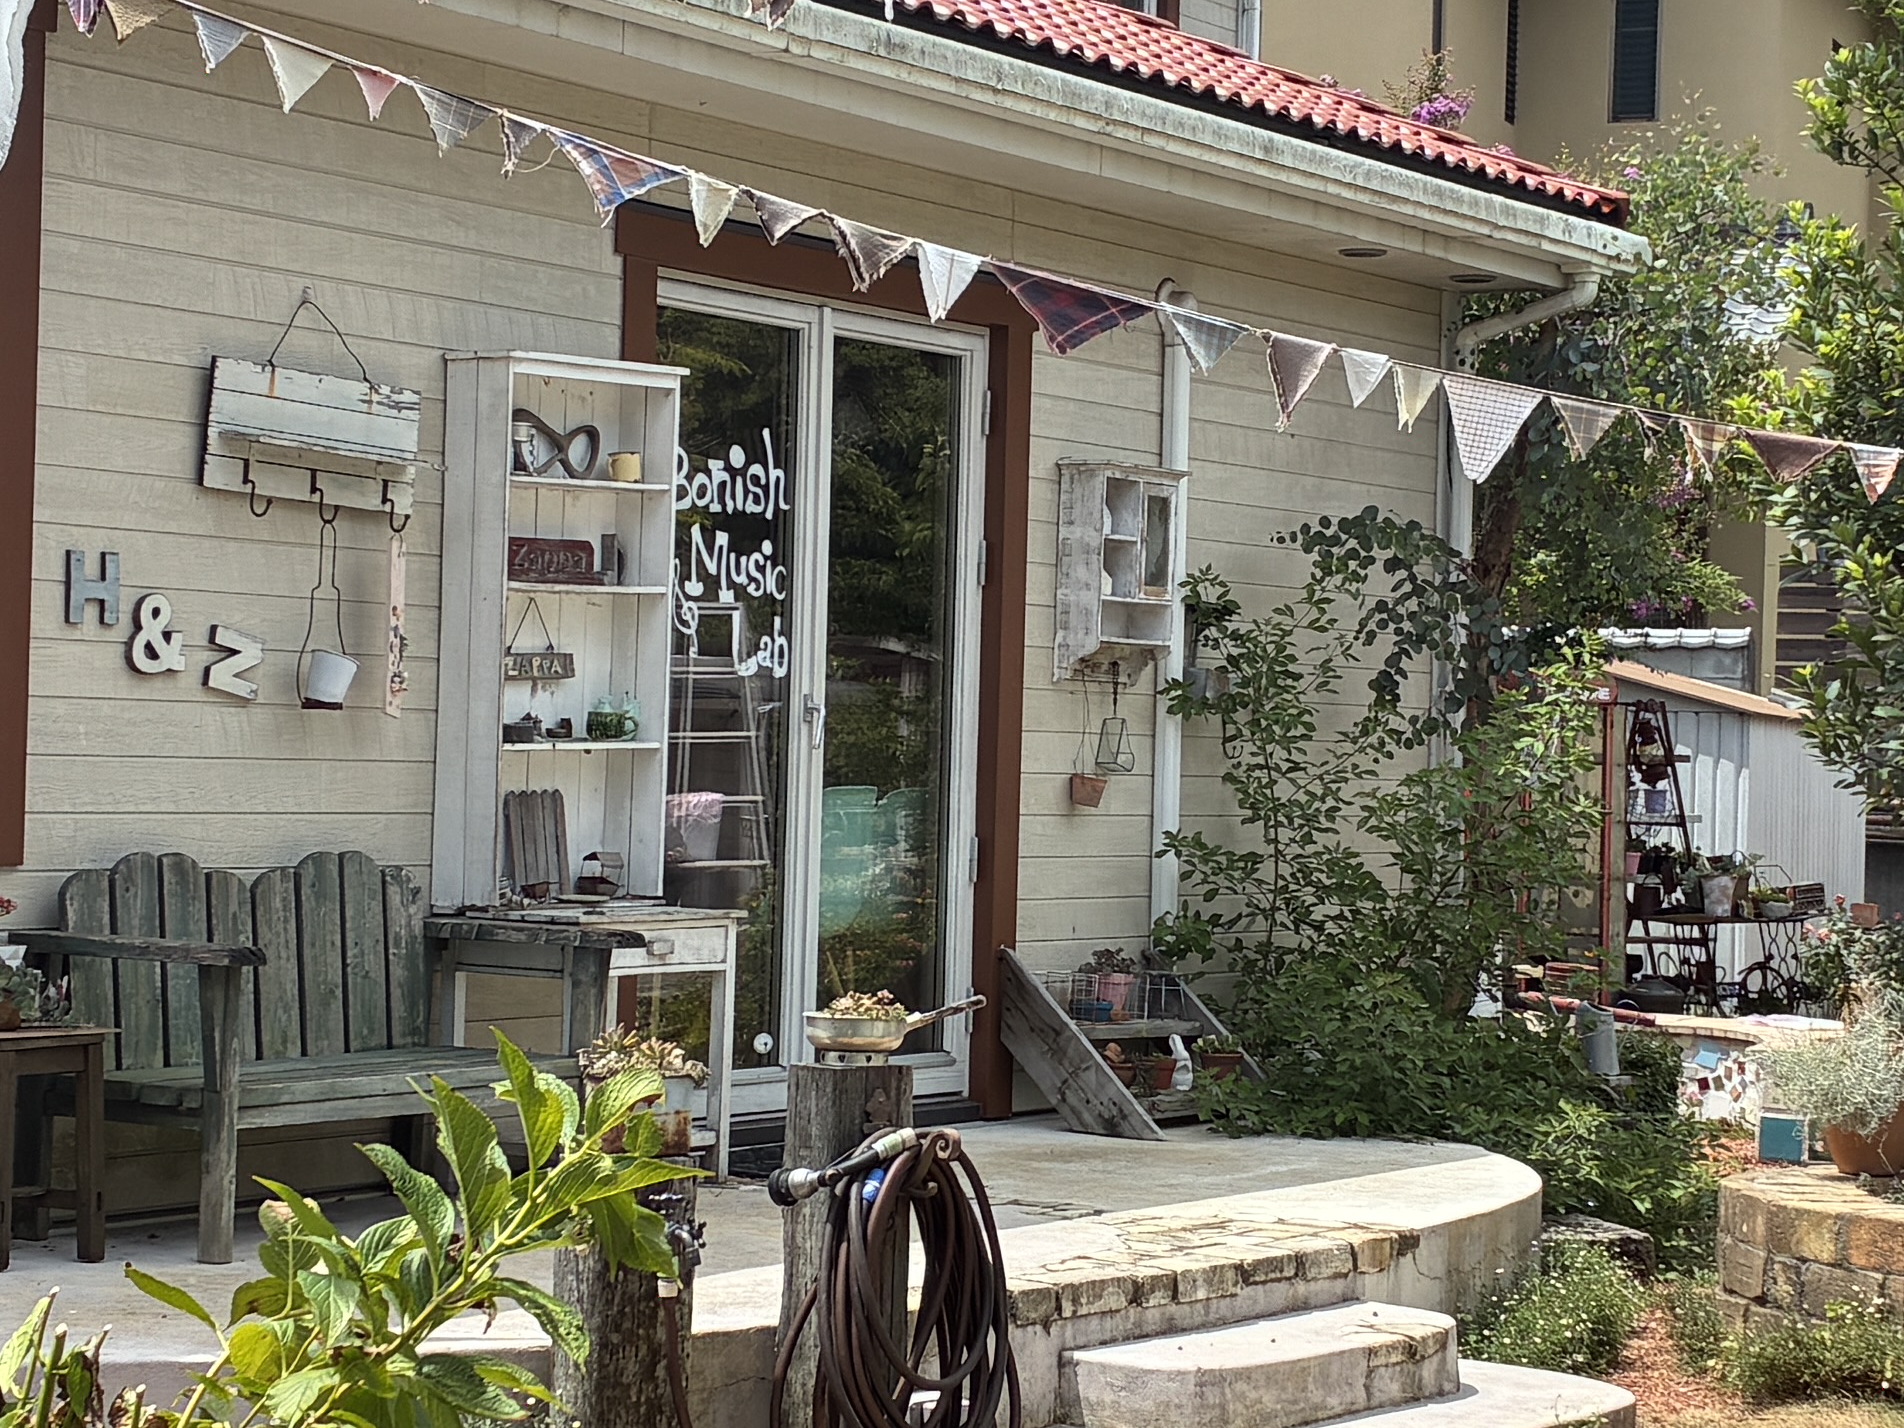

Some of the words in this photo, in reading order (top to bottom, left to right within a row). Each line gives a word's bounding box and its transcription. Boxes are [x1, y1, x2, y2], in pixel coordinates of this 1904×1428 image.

[675, 427, 791, 520] Bonish
[511, 543, 588, 575] Zappa
[684, 523, 787, 604] Music
[64, 549, 121, 625] H
[124, 592, 186, 675] &
[732, 615, 789, 678] Lab
[504, 656, 563, 677] ZAPPA
